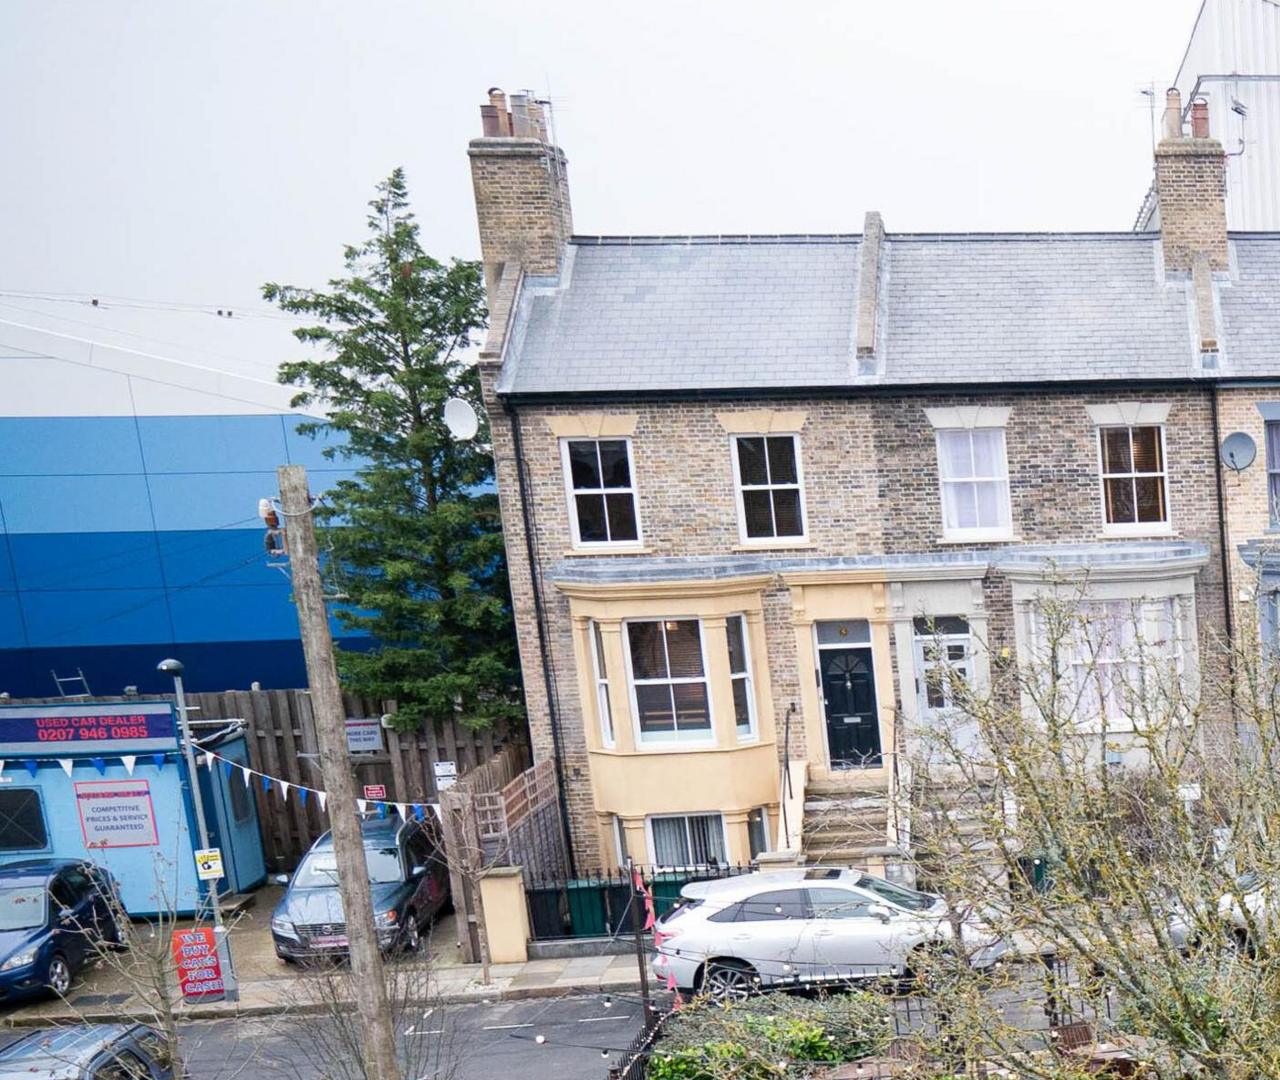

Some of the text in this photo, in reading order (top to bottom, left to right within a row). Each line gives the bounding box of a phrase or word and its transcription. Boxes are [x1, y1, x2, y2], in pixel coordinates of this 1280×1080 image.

[36, 714, 146, 728] USED CAR DEALER
[38, 726, 148, 741] 0207 946 0985
[91, 805, 140, 813] COMPETITIVE
[86, 815, 111, 823] PRICES
[112, 814, 118, 822] &
[94, 824, 144, 833] GUARANTEED
[181, 933, 206, 944] WE
[182, 945, 209, 957] BUY
[182, 956, 217, 968] CARS
[188, 969, 215, 981] FOR
[185, 981, 224, 993] CASH
